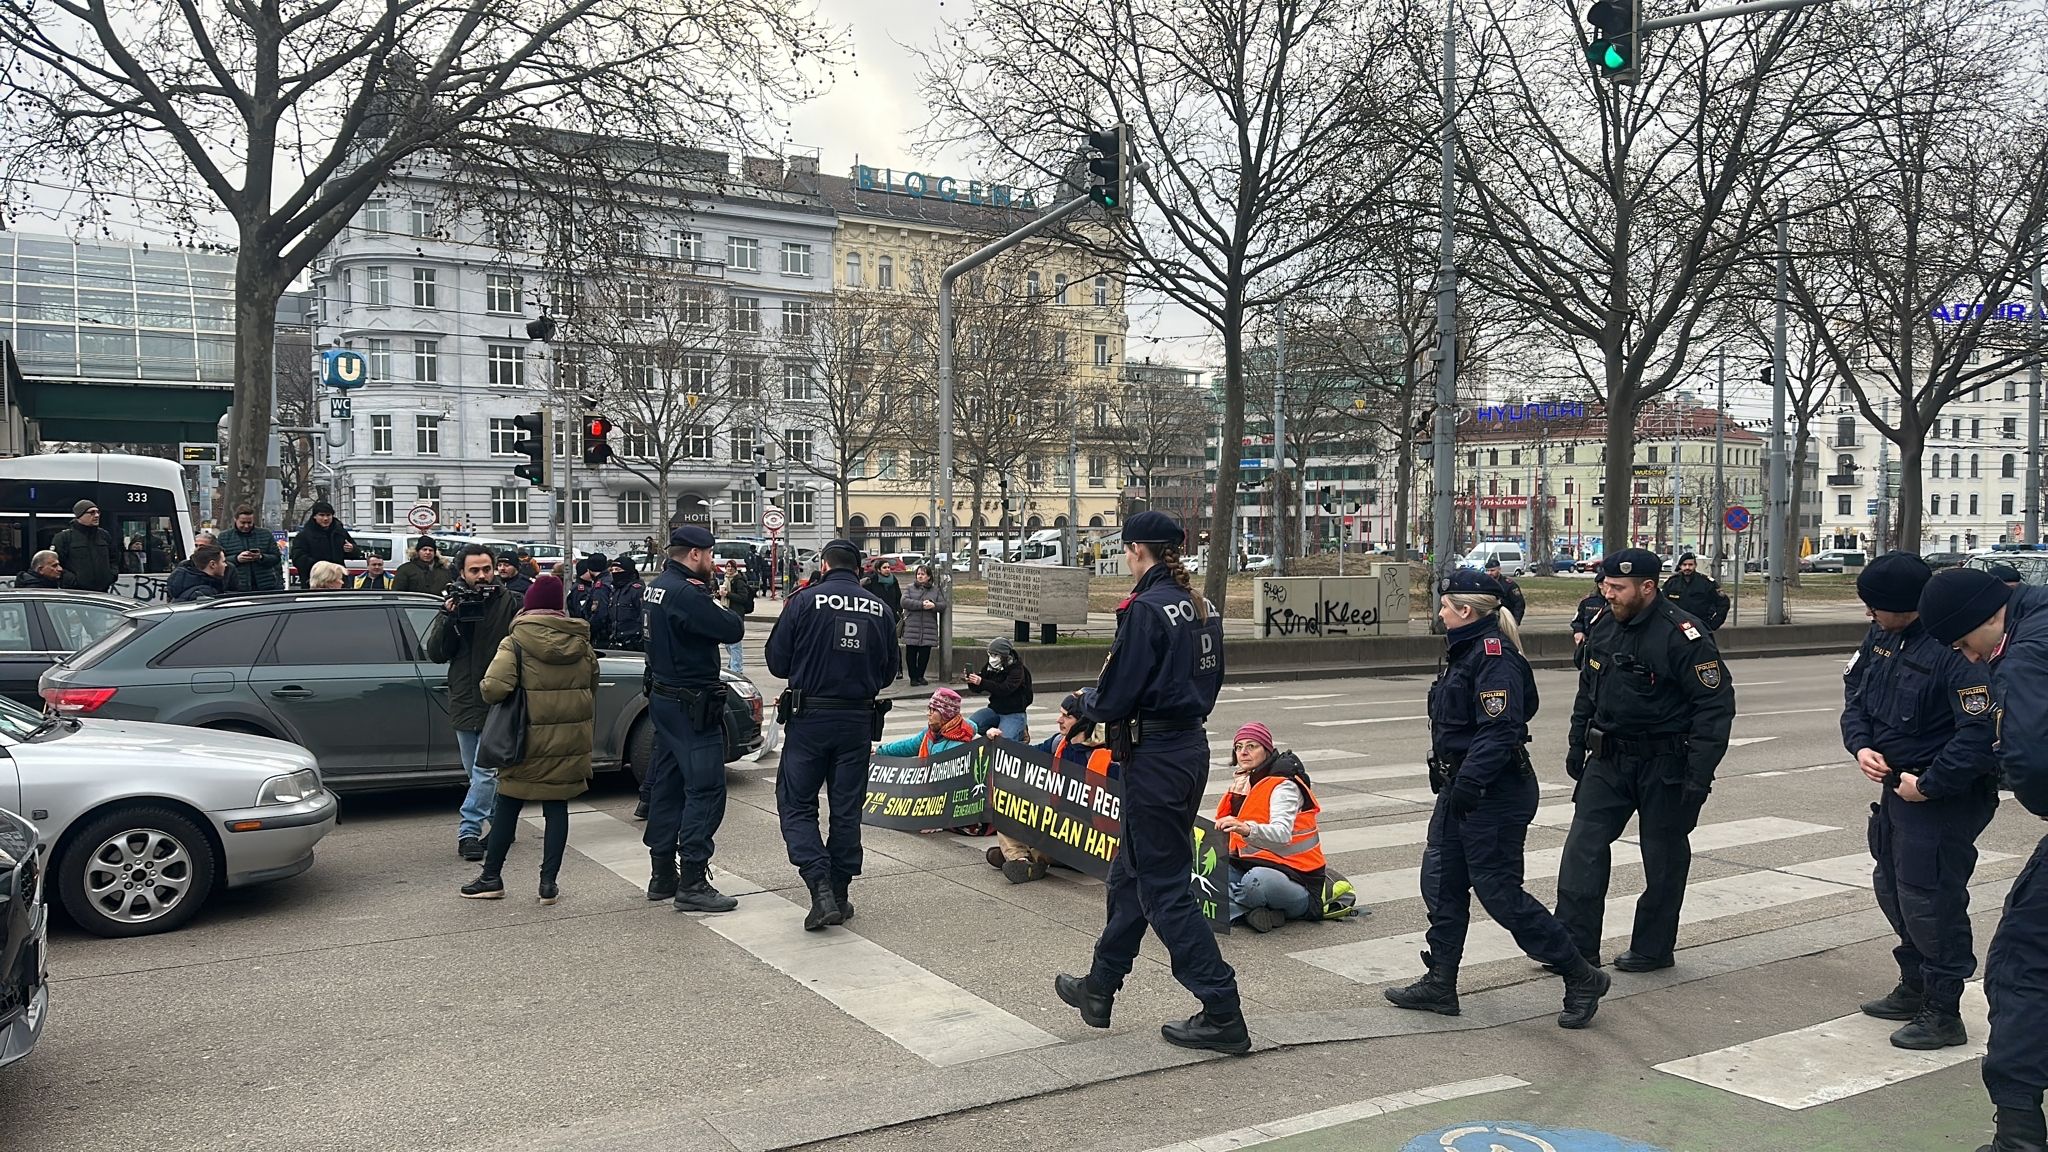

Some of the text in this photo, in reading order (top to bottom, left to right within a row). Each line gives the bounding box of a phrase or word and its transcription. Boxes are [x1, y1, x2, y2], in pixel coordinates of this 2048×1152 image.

[859, 164, 1038, 210] BIOGENA
[338, 357, 360, 381] U
[332, 399, 350, 409] WC
[1478, 401, 1584, 422] HYUNDAI
[127, 492, 148, 503] 333
[684, 513, 709, 521] HOTE
[815, 594, 884, 617] POLIZEI
[844, 621, 858, 637] D
[840, 637, 860, 649] 353
[1200, 634, 1213, 654] D
[1199, 655, 1217, 670] 353
[896, 766, 930, 785] NEUEN
[929, 751, 972, 783] BOHRUNGEN!
[994, 748, 1121, 822] UND WENN DIE REG
[883, 797, 913, 816] SIND
[911, 792, 947, 816] GENUG!
[992, 786, 1038, 829] KEINEN
[1040, 806, 1082, 848] PLAN
